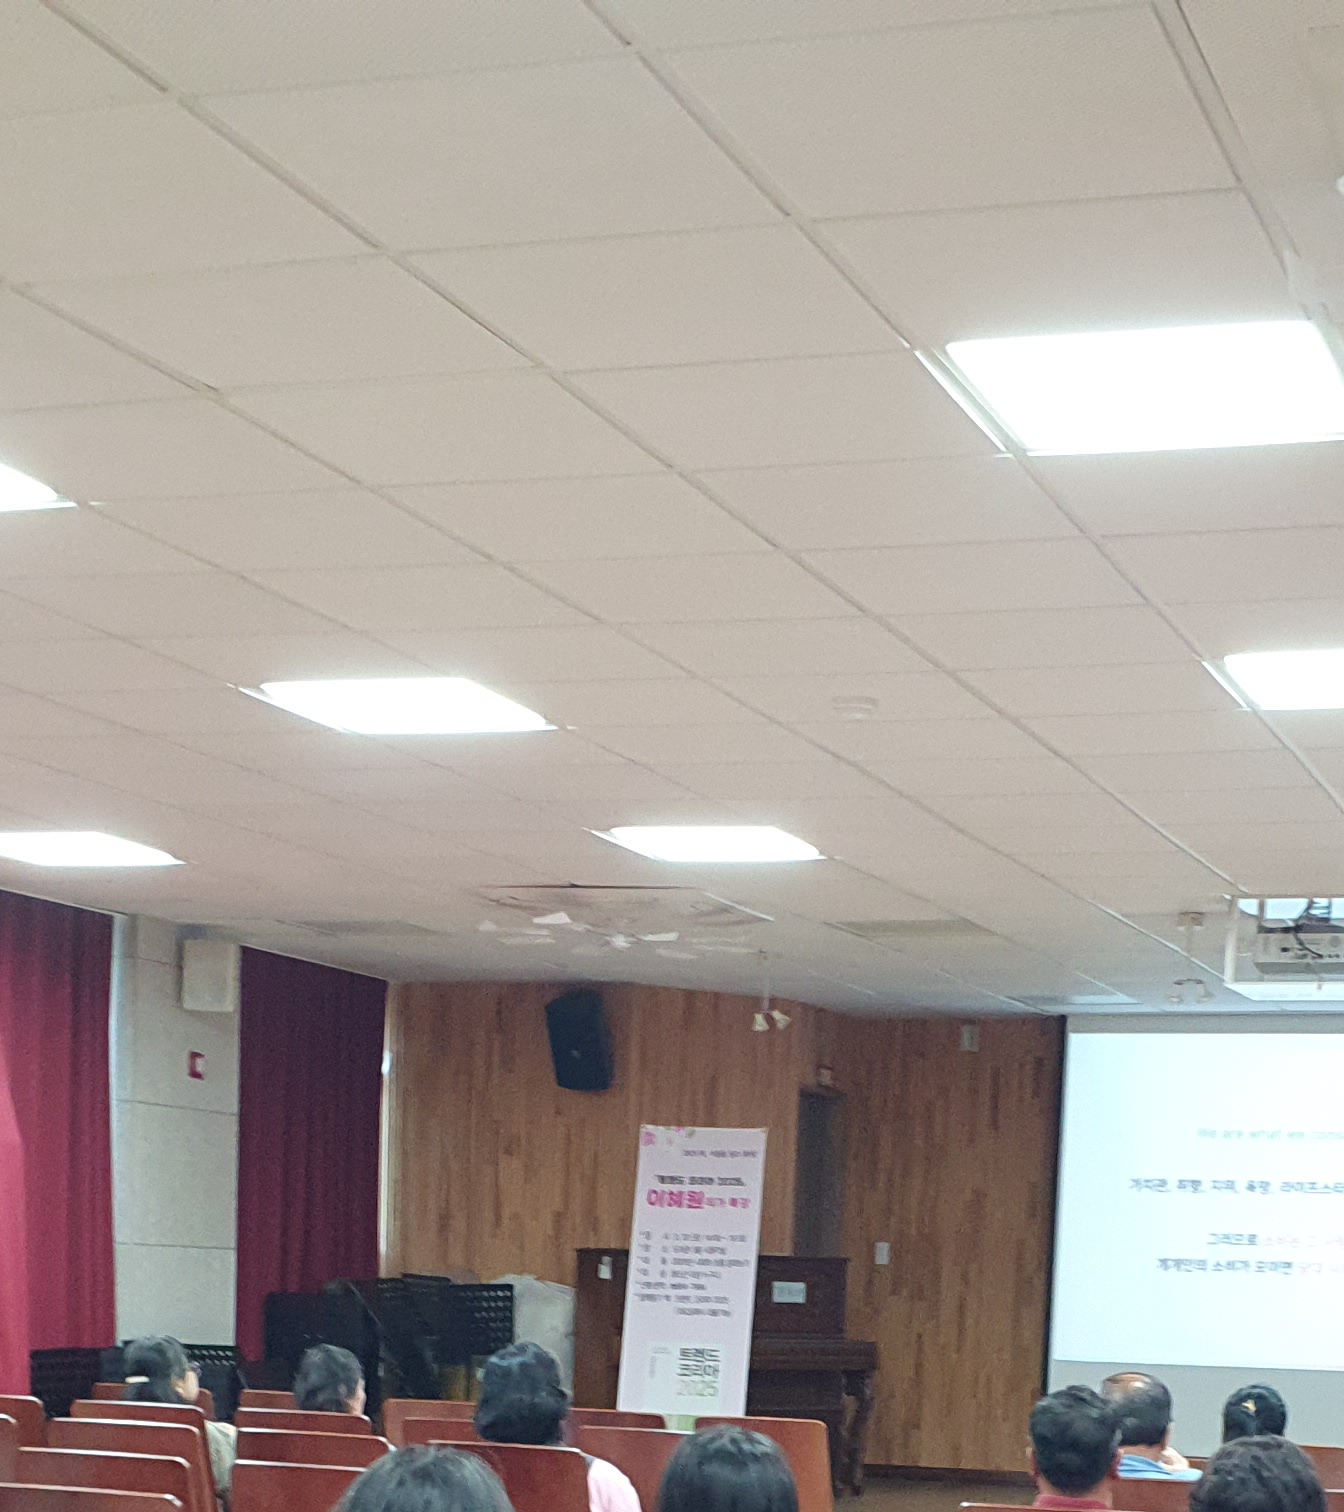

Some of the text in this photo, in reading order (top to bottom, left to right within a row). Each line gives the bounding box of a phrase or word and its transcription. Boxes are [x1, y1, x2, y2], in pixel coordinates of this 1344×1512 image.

[678, 1347, 721, 1363] 트렌드
[676, 1363, 720, 1378] 코리아
[676, 1379, 719, 1397] 2025
